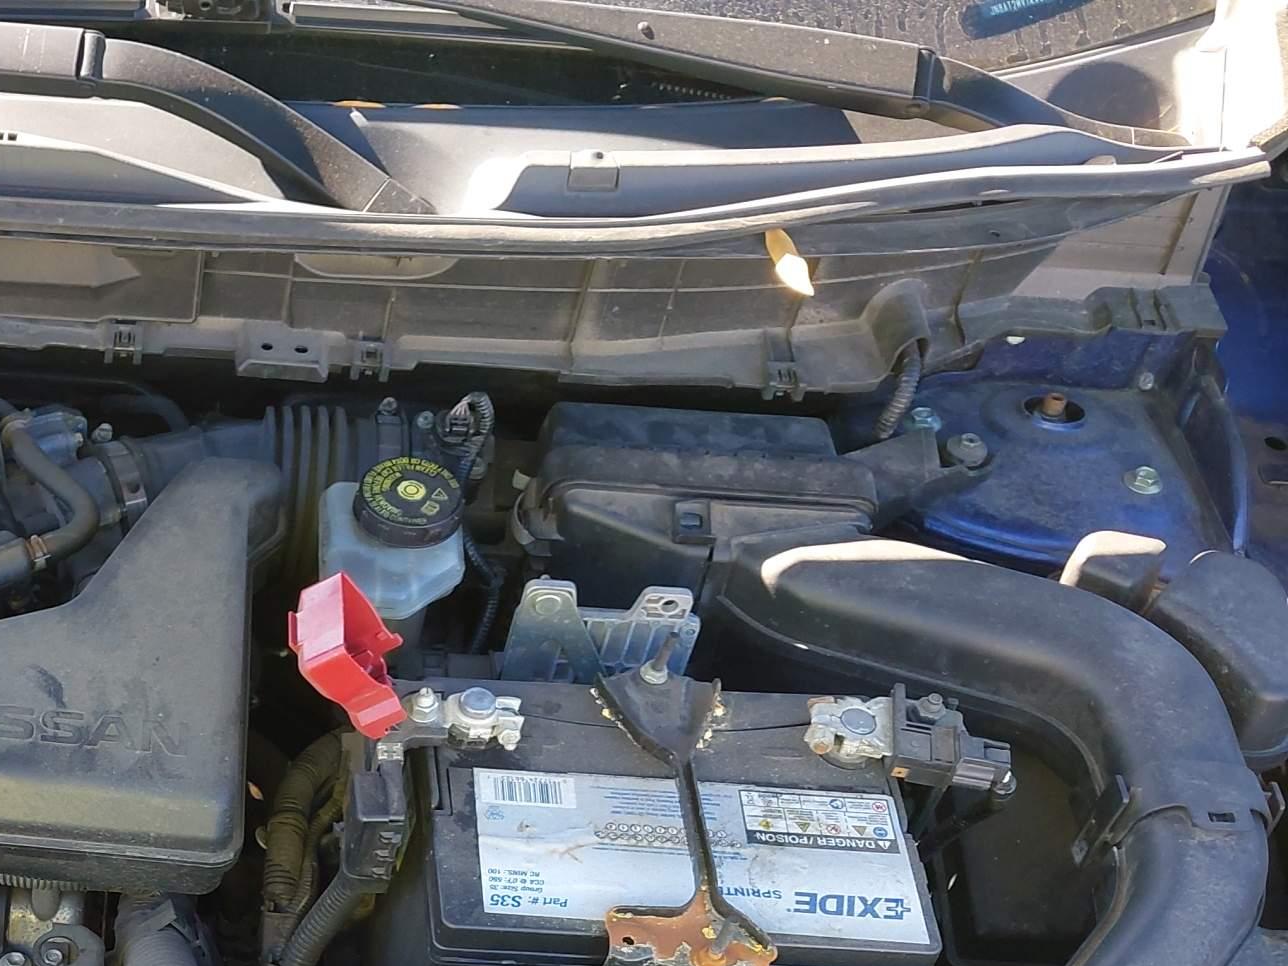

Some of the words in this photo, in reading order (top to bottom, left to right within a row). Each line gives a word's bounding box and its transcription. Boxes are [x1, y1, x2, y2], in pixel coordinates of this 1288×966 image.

[755, 832, 808, 844] POISON
[818, 837, 875, 849] DANGER
[490, 894, 522, 907] S35
[528, 896, 539, 904] #:
[543, 897, 568, 907] Part
[795, 891, 911, 920] EXIDE
